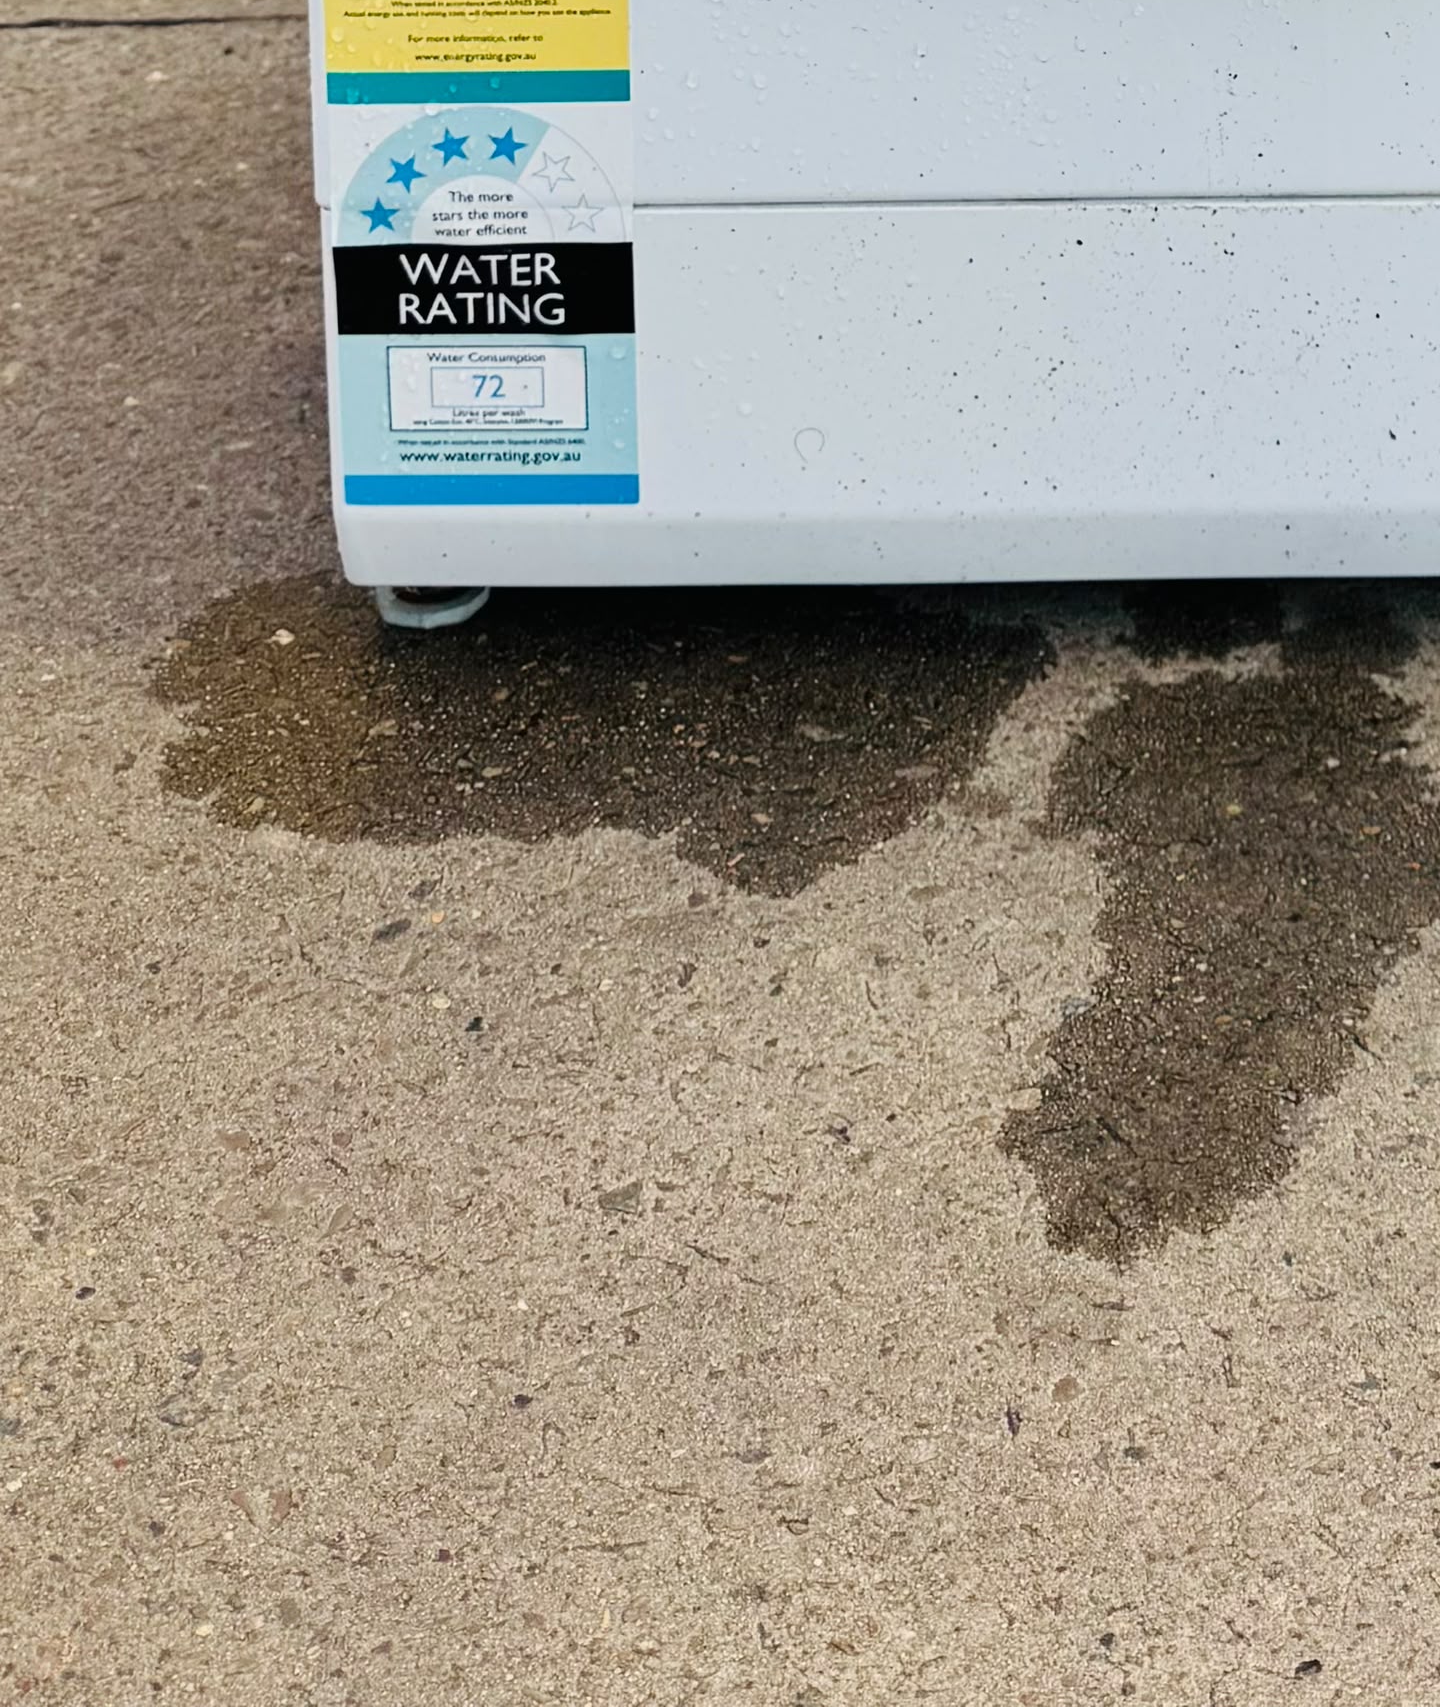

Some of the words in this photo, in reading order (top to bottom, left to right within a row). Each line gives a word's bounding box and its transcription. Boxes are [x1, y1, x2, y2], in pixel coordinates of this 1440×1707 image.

[408, 34, 423, 43] For
[425, 35, 450, 44] more
[508, 33, 532, 43] refer
[533, 34, 543, 43] to
[448, 191, 473, 203] The
[478, 192, 514, 202] more
[432, 210, 463, 221] stars
[467, 209, 489, 220] the
[493, 209, 529, 219] more
[434, 226, 471, 236] water
[476, 224, 527, 236] efficient
[399, 252, 561, 286] WATER
[400, 291, 566, 325] RATING
[426, 352, 465, 363] Water
[469, 352, 546, 365] Consumption
[472, 374, 506, 398] 72
[482, 409, 499, 419] per
[502, 408, 526, 418] wash
[400, 449, 581, 465] www.waterrating.gov.au
